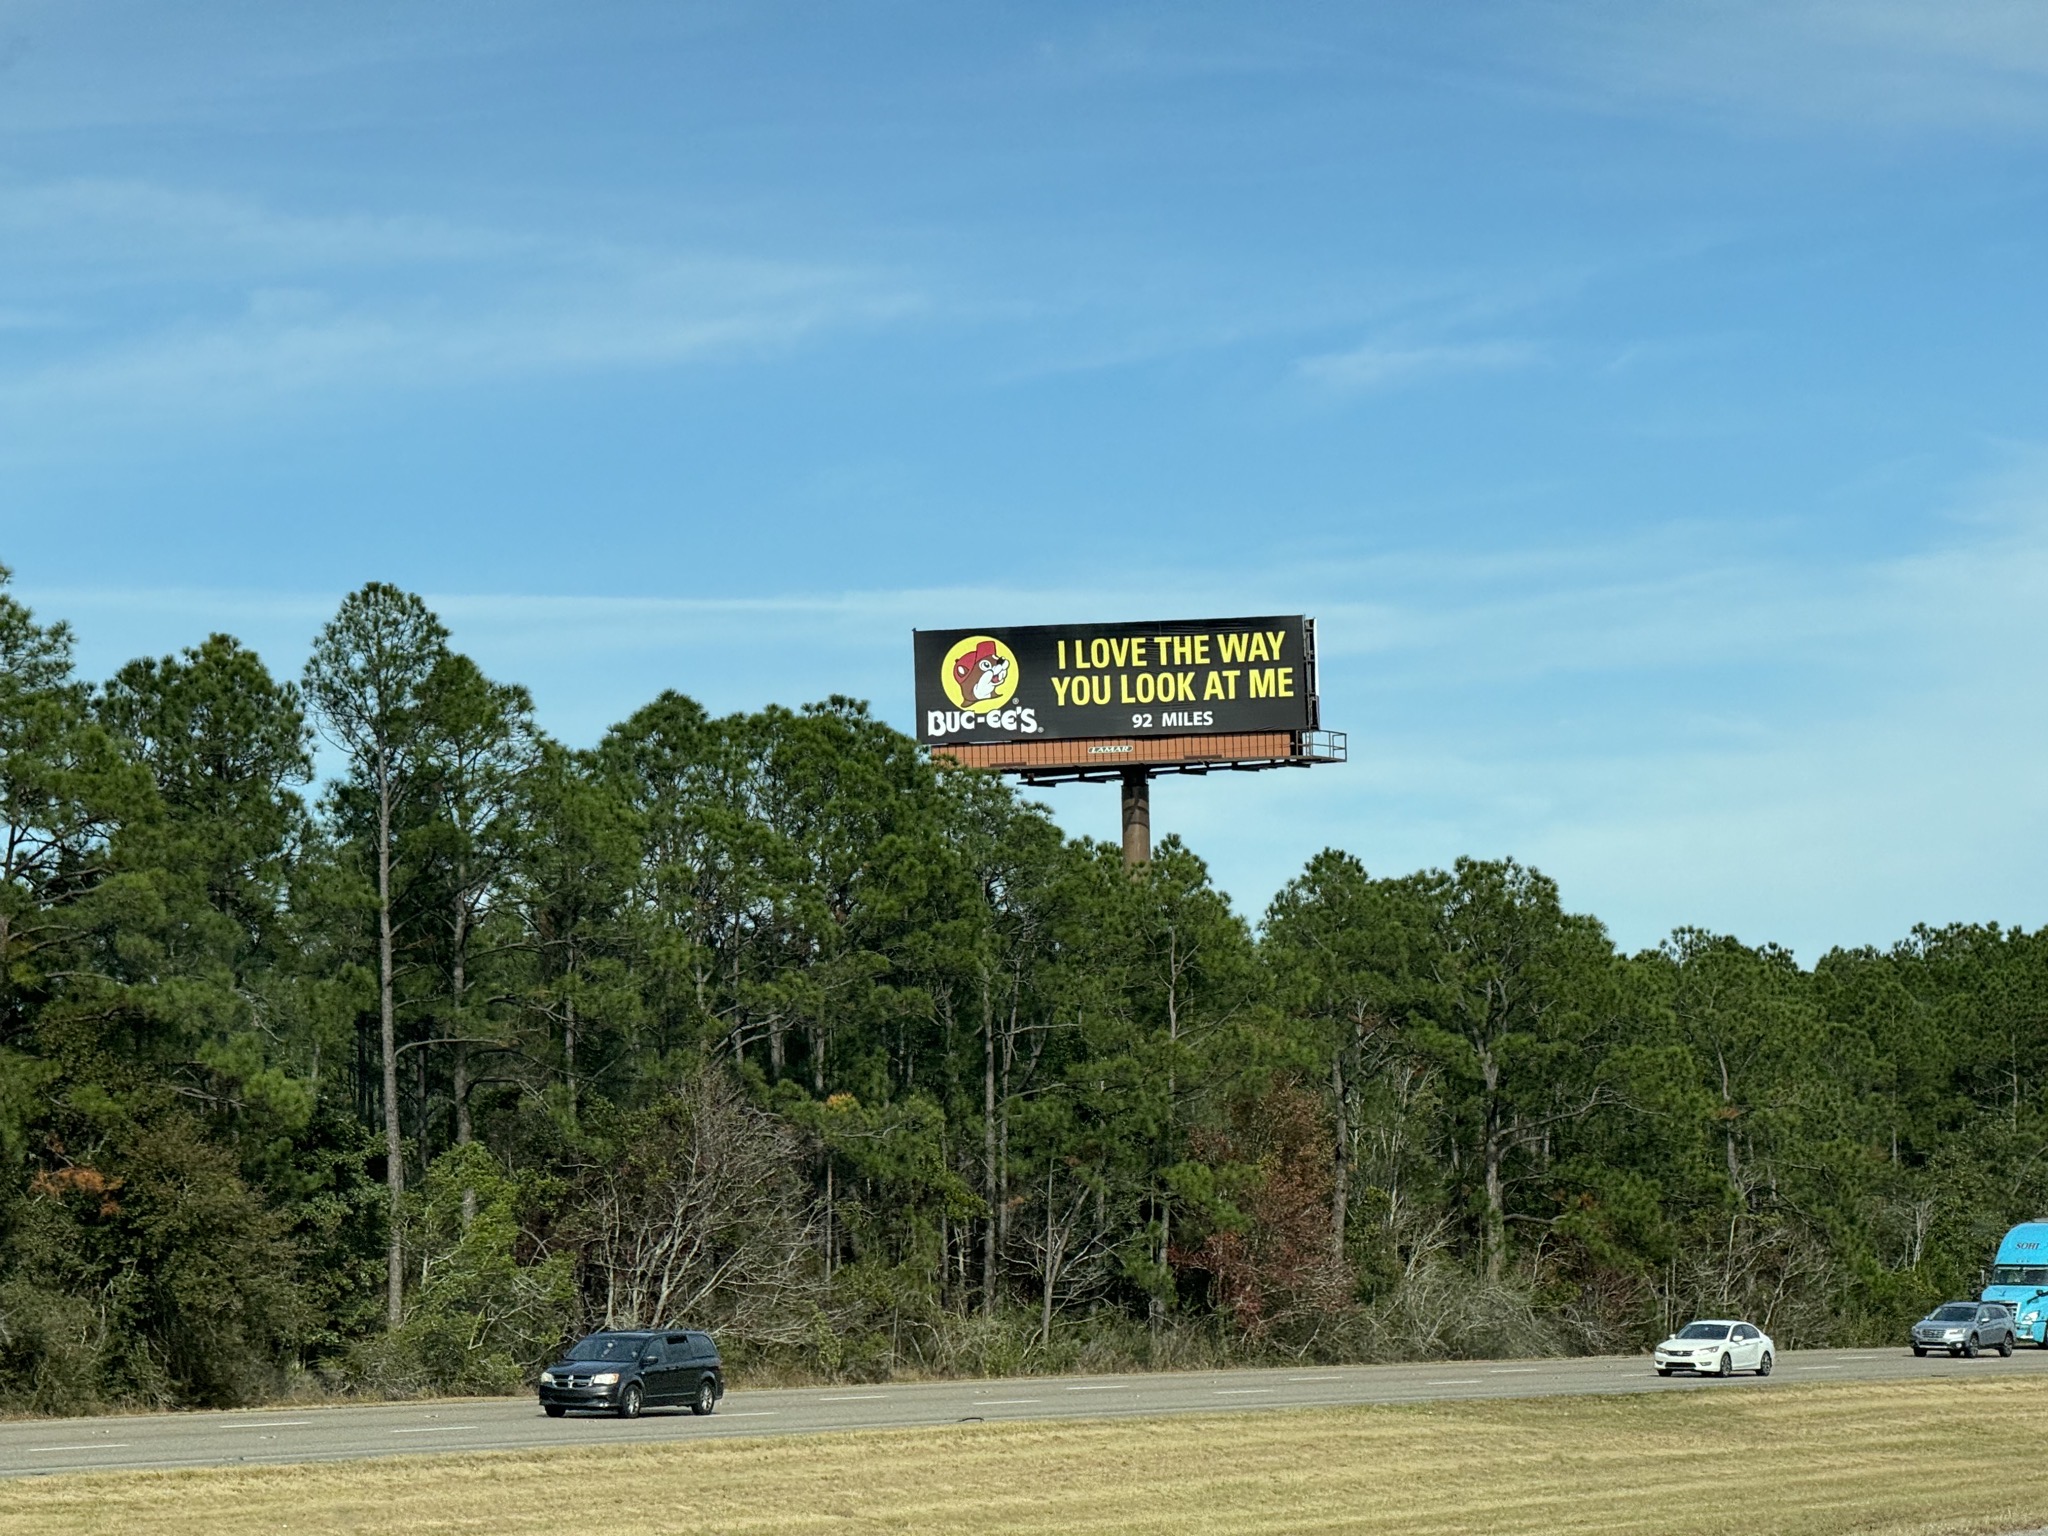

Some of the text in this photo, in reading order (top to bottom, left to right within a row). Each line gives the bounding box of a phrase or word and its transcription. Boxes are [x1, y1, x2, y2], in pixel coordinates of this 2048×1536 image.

[1058, 631, 1286, 669] I LOVE THE WAY
[1051, 668, 1295, 706] YOU LOOK AT ME
[1132, 711, 1214, 728] 92 MILES
